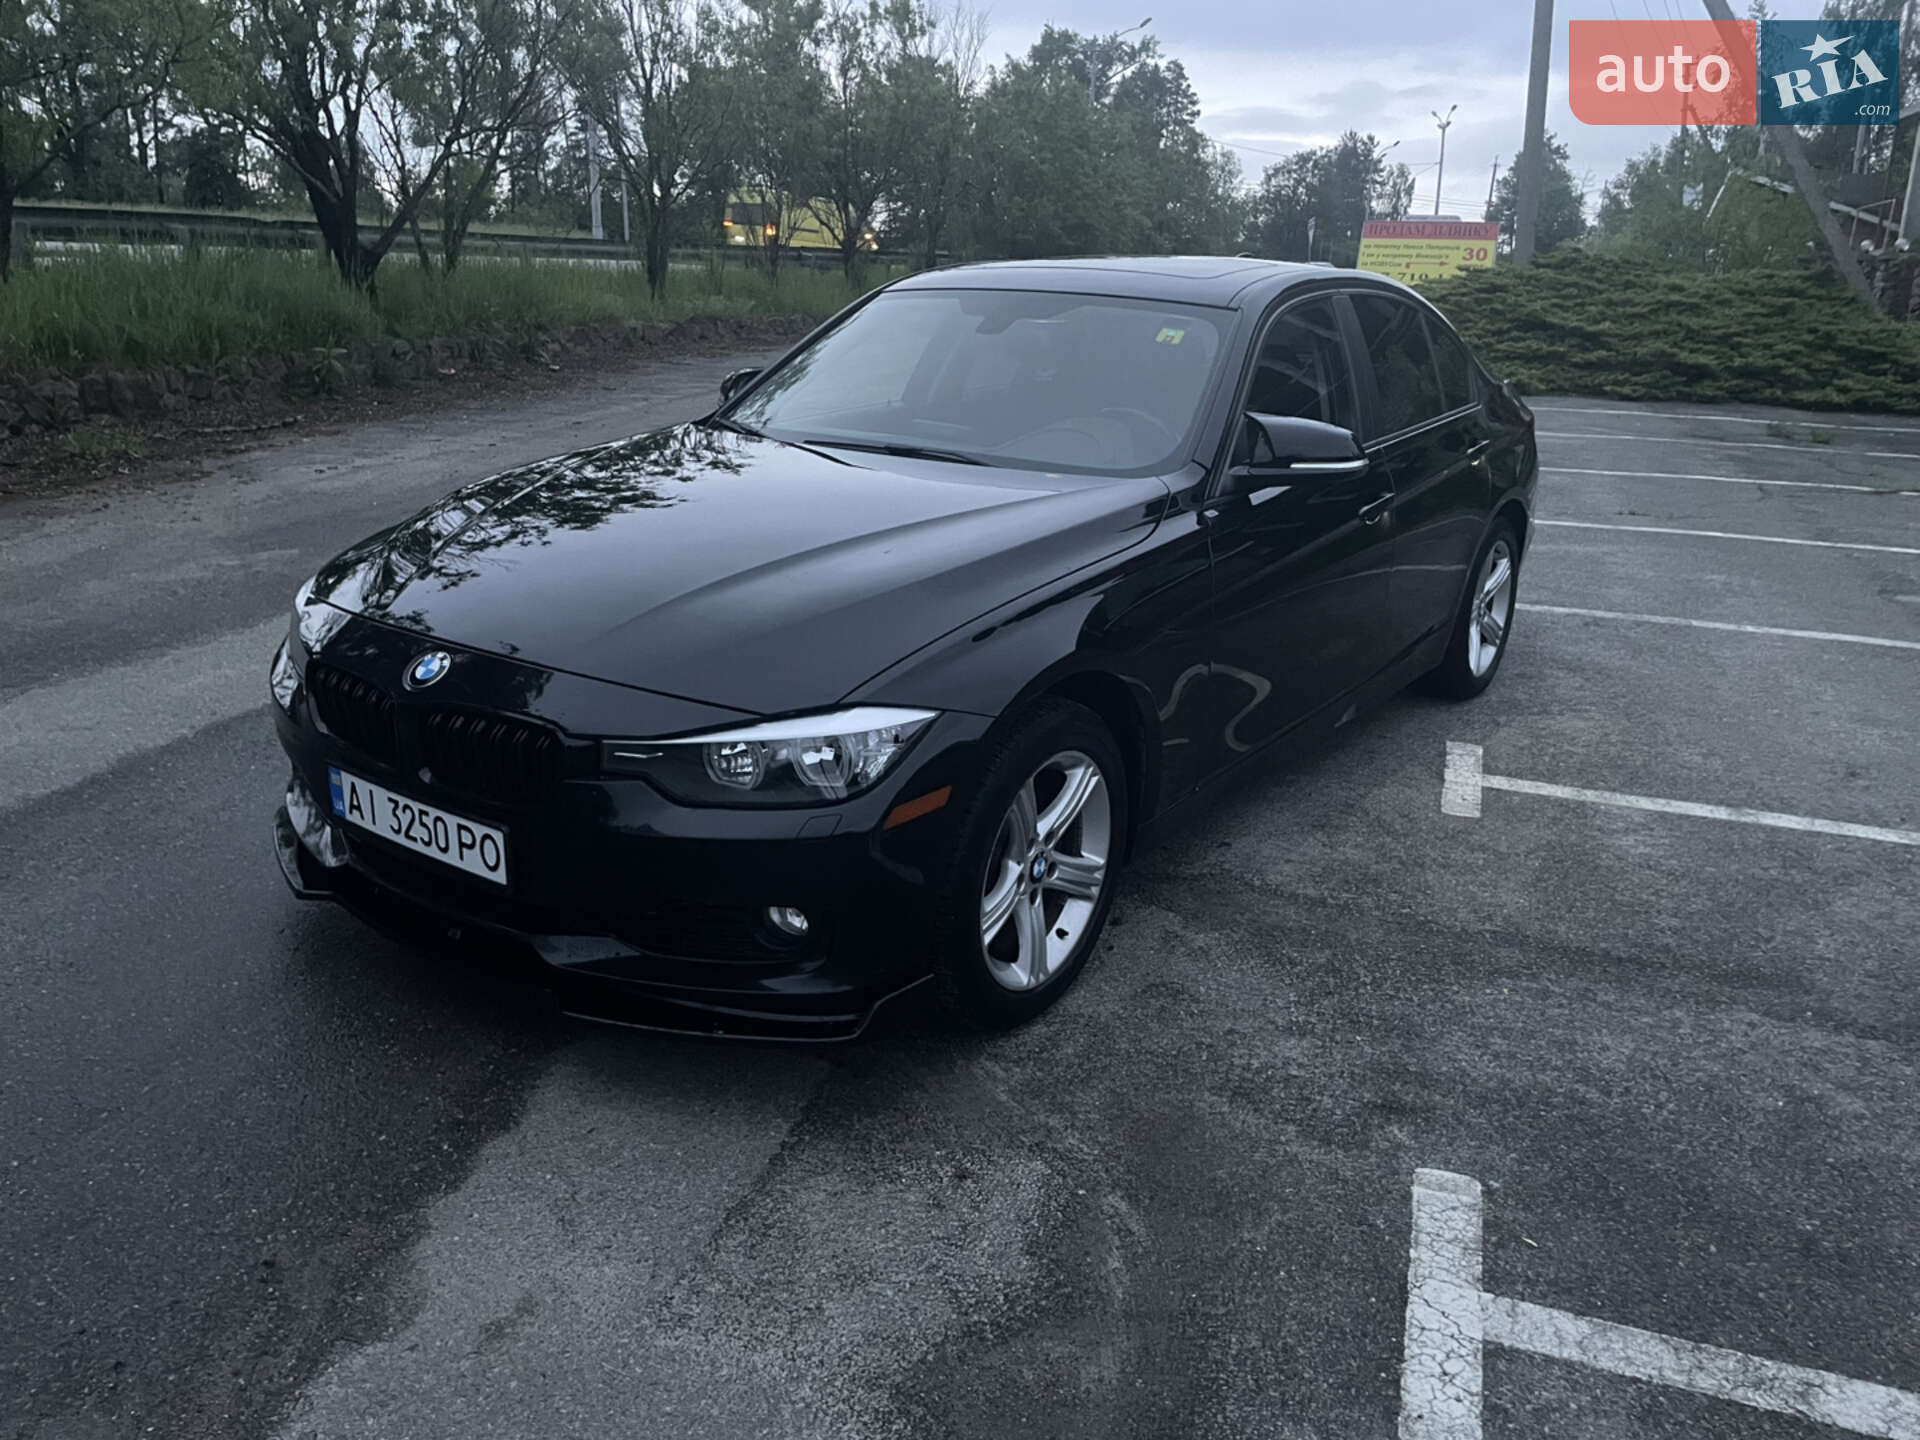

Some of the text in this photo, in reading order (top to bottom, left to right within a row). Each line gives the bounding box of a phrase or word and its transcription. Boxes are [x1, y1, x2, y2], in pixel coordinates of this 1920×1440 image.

[1462, 247, 1489, 262] 30
[348, 781, 501, 873] AI 3250 PO
